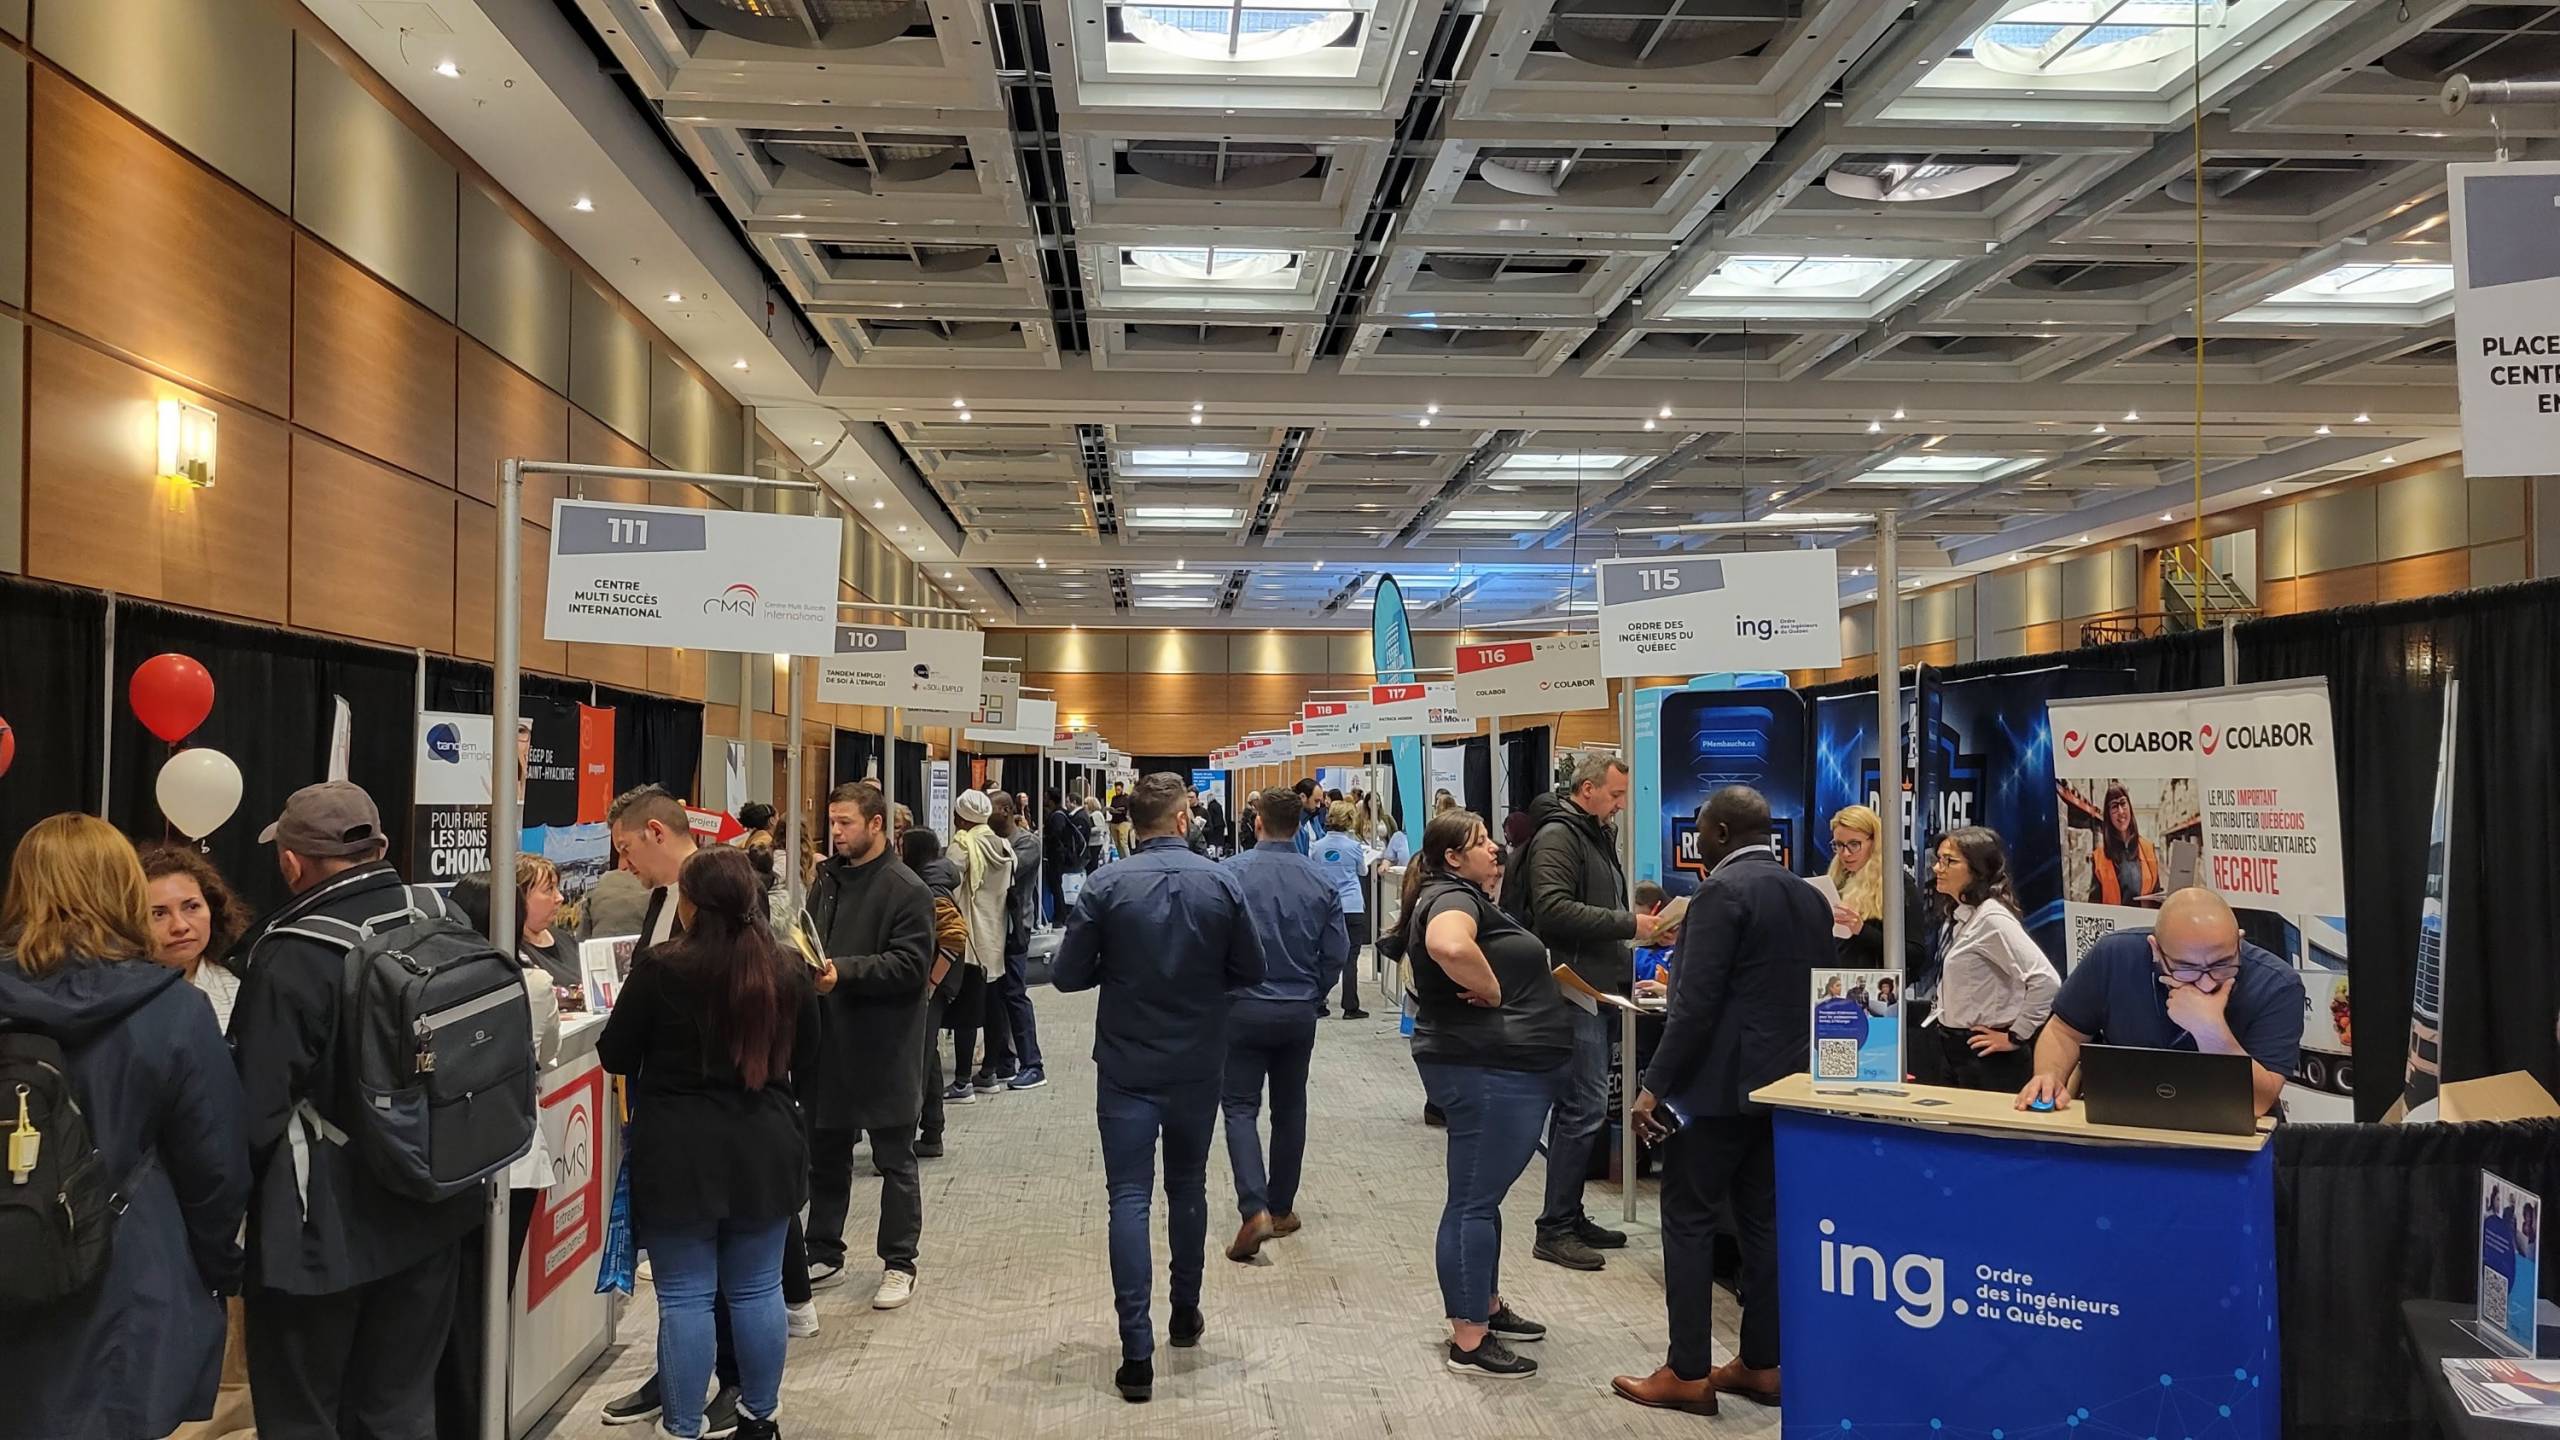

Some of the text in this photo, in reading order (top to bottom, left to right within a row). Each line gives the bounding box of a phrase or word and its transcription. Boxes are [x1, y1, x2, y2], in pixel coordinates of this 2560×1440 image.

[607, 517, 649, 545] 111
[594, 578, 640, 591] CENTRE
[1638, 568, 1681, 592] 115
[574, 590, 658, 605] MULTI SUCCÈS
[568, 603, 662, 619] INTERNATIONAL
[1628, 621, 1684, 632] ORDRE DES
[1736, 614, 1779, 640] ing.
[848, 631, 877, 648] 110
[1618, 630, 1694, 643] INGÉNIEURS DU
[1636, 641, 1677, 654] QUÉBEC
[1478, 649, 1506, 664] 116
[827, 669, 855, 678] TANDEM
[857, 671, 882, 679] EMPLOI
[849, 676, 855, 684] À
[1475, 688, 1506, 696] COLABOR
[1553, 679, 1595, 689] COLABOR
[1388, 688, 1406, 699] 117
[2094, 730, 2194, 754] COLABOR
[2225, 722, 2314, 750] COLABOR
[436, 740, 477, 750] tandem
[461, 750, 492, 761] emplo
[528, 745, 554, 764] ÉGEP DE
[526, 766, 575, 781] AINT-HYACINTHE
[2208, 788, 2278, 806] LE PLUS IMPORTANT
[431, 811, 488, 829] POUR FAIRE
[689, 815, 718, 829] projets
[2209, 809, 2305, 830] DISTRIBUTEUR QUÉBÉCOIS
[430, 828, 487, 848] LES BONS
[2211, 833, 2317, 854] DE PRODUITS ALIMENTAIRES
[2213, 855, 2280, 895] RECRUTE
[1819, 1218, 1969, 1329] ing.
[1976, 1263, 2033, 1287] Ordre
[1976, 1284, 2120, 1317] des ingénieurs
[1976, 1303, 2083, 1331] du Québec
